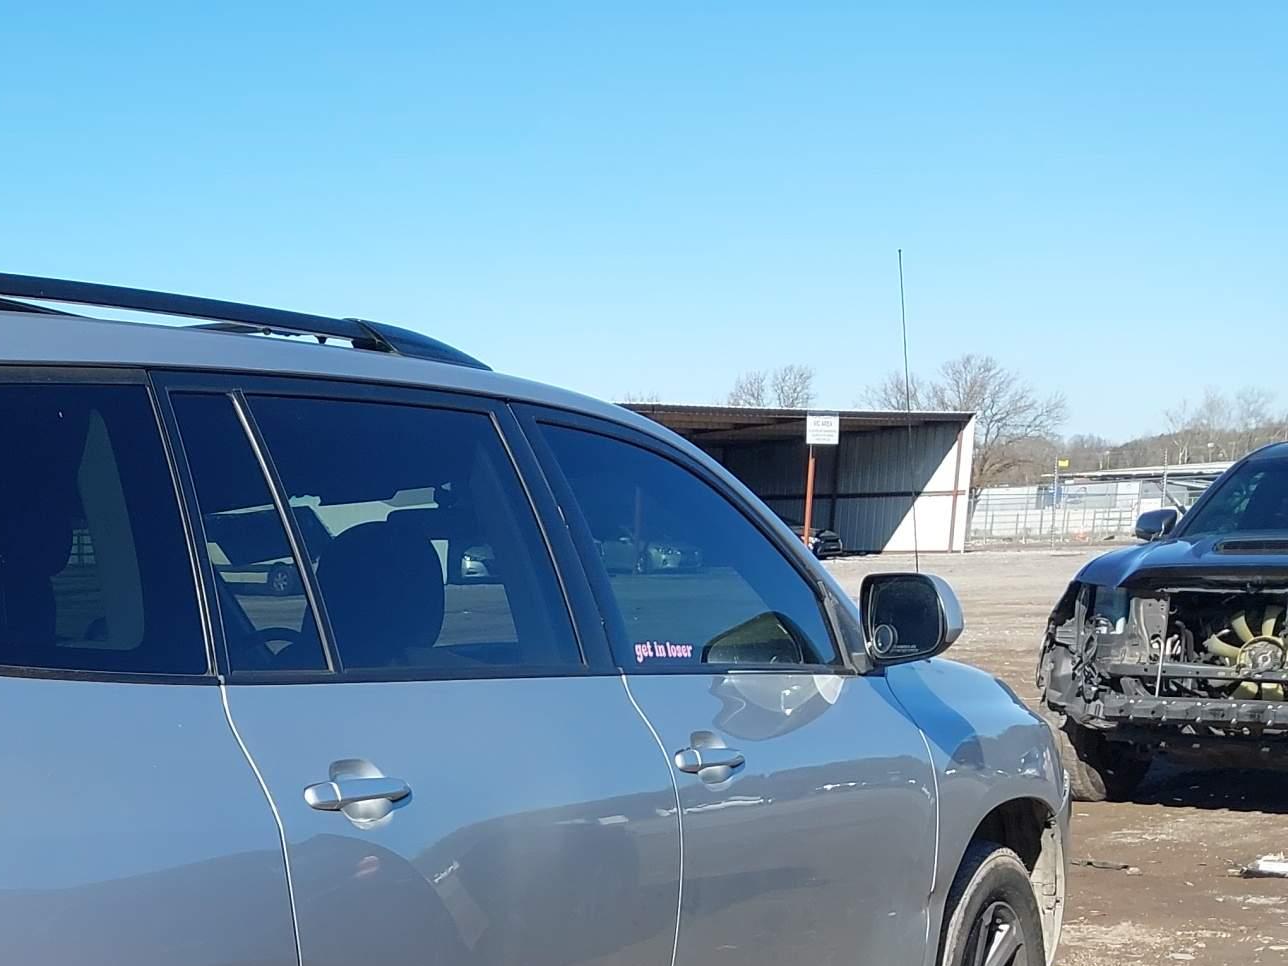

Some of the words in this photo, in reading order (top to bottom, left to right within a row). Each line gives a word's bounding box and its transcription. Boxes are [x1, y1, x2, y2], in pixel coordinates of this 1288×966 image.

[635, 641, 653, 663] get
[654, 641, 666, 657] in
[666, 642, 692, 657] loser
